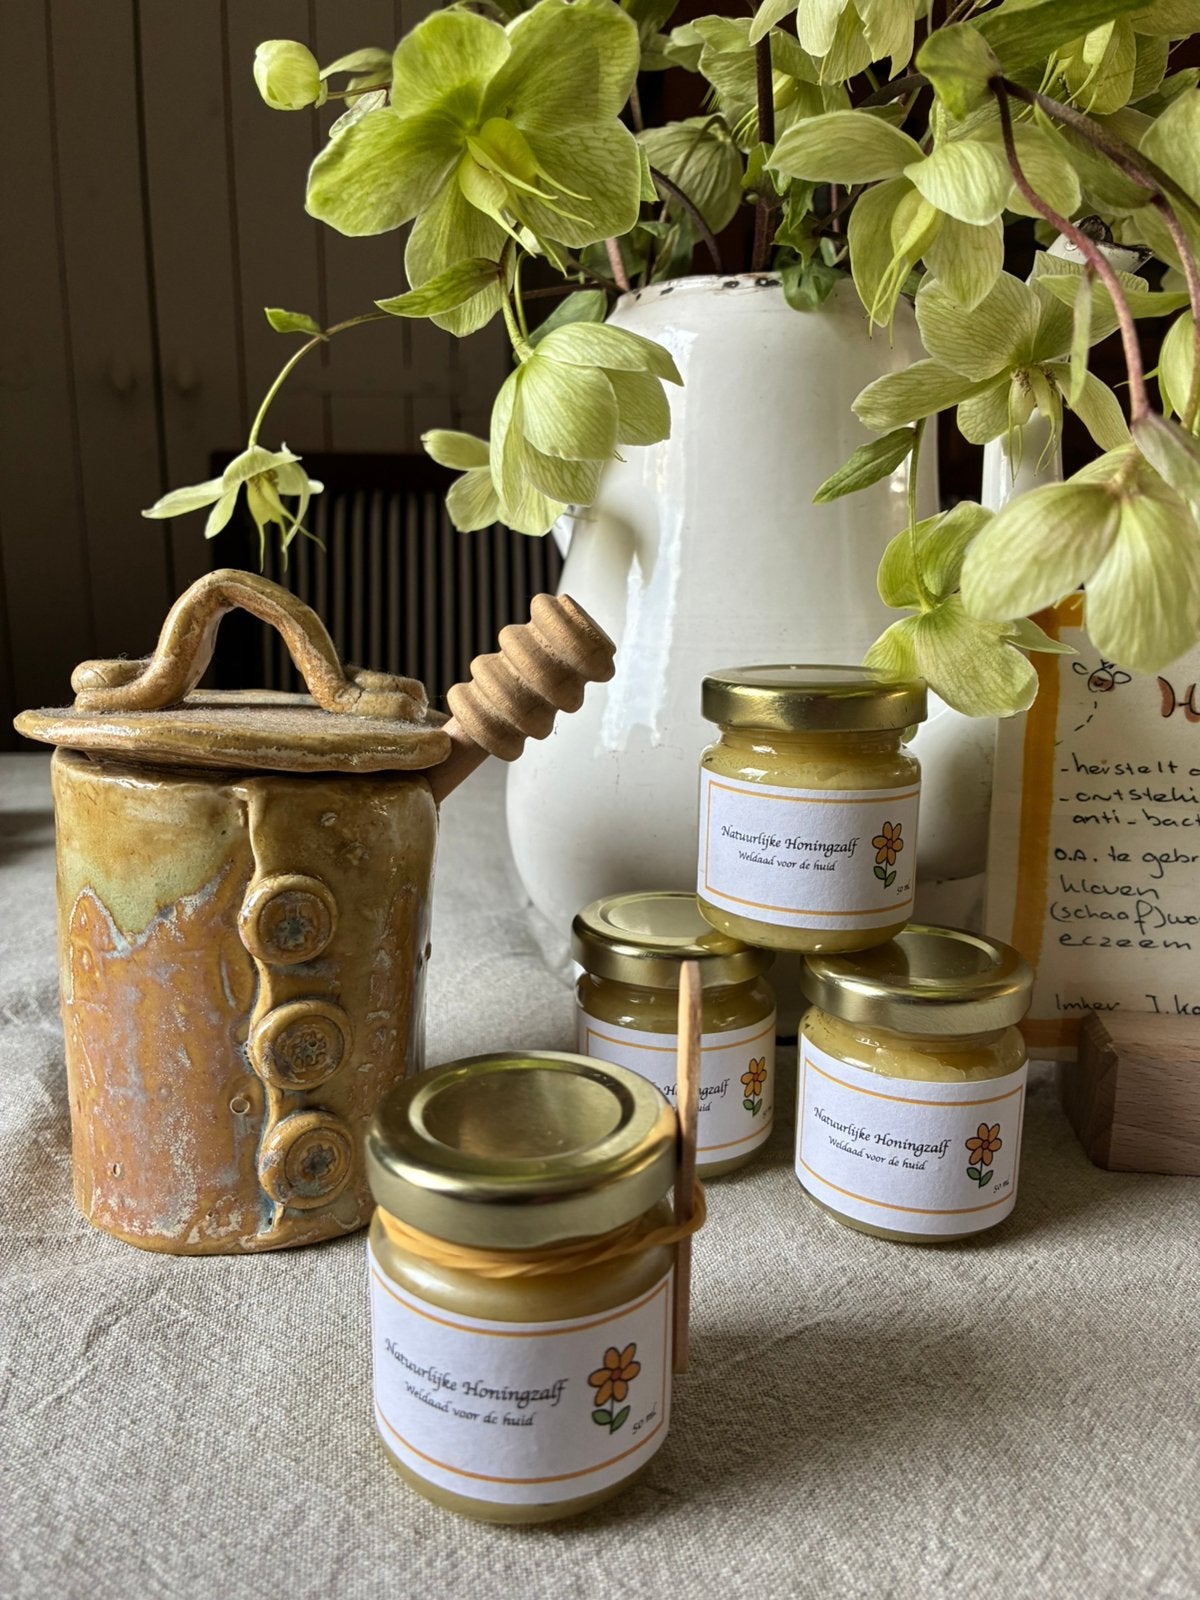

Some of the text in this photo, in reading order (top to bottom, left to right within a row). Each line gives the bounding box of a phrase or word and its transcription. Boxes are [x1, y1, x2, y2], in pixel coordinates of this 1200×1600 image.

[721, 825, 860, 858] Natuurlijke Honingzalf
[1108, 845, 1131, 862] te
[738, 850, 837, 871] Weldaad voor de huid
[1059, 933, 1191, 950] eczeem
[813, 1106, 952, 1158] Natuurlijke Honingzalf
[828, 1135, 928, 1171] Weldaad voor de huid
[385, 1338, 568, 1409] Natuurlijke Honingzalf
[405, 1381, 537, 1427] Weldaad voor de huid
